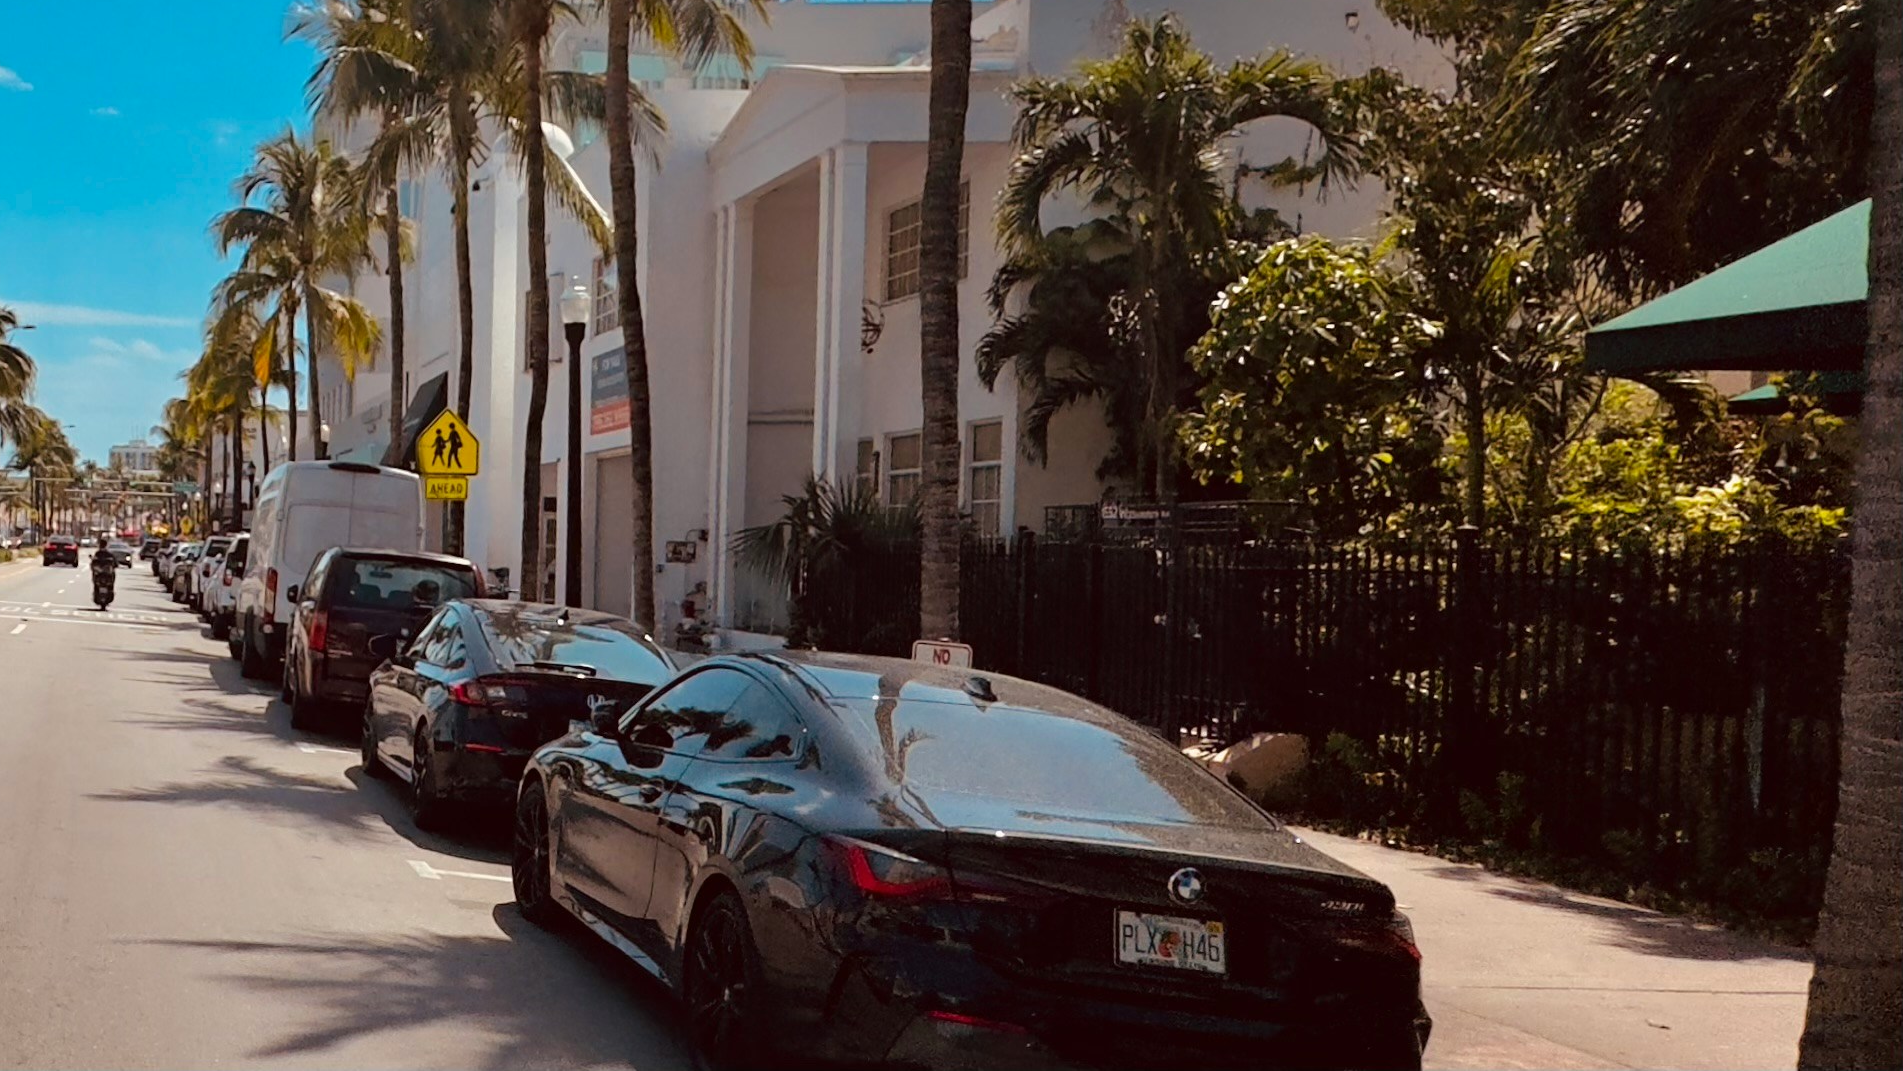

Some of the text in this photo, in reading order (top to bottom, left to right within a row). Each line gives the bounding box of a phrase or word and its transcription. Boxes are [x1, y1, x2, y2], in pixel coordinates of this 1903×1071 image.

[429, 482, 464, 495] AHEAD
[932, 648, 951, 666] NO
[1122, 924, 1221, 962] PLX H46
